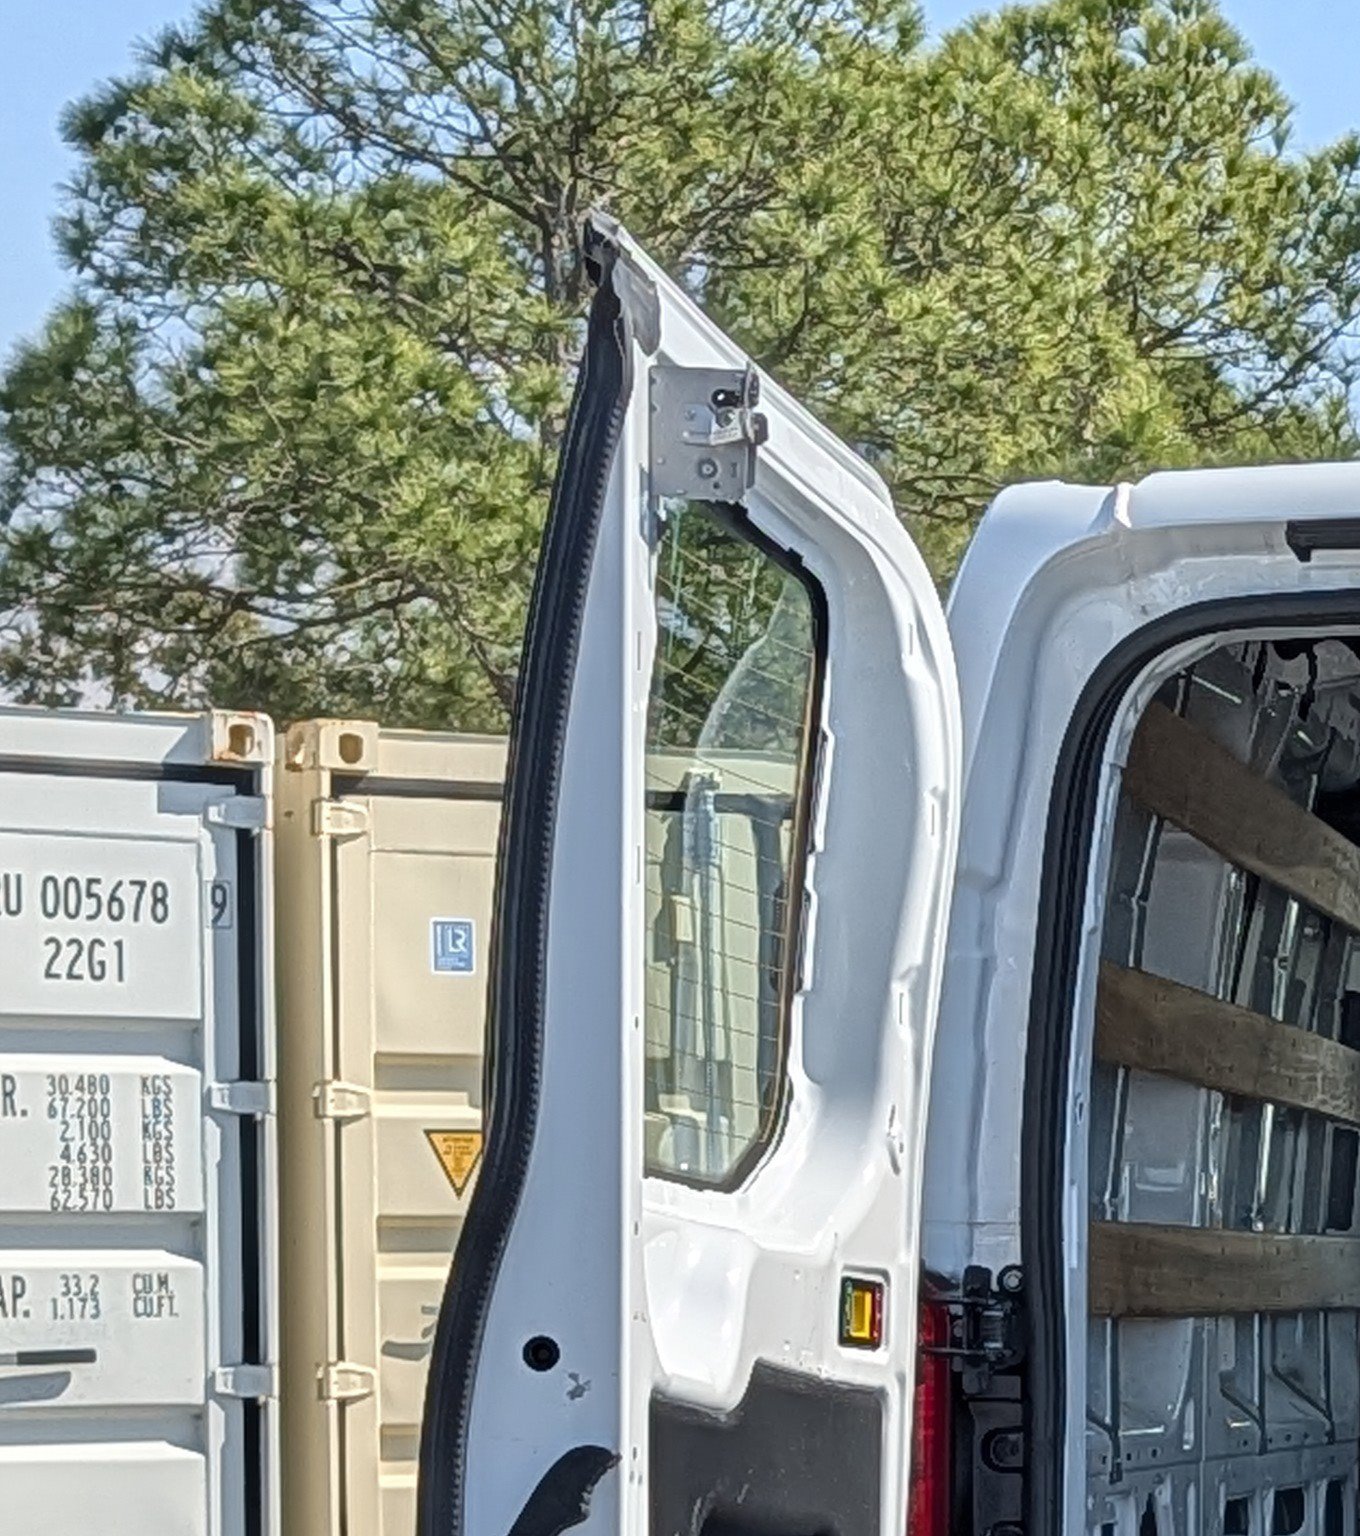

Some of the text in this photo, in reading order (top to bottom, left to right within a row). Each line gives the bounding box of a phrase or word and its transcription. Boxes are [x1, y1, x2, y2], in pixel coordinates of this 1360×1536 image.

[0, 873, 228, 925] U 005678 9
[43, 936, 124, 982] 22G1
[140, 1074, 173, 1096] KGS
[47, 1096, 173, 1119] 67.200 LBS
[59, 1118, 173, 1142] 2.100 KGS
[59, 1141, 175, 1165] 4.630 LBS
[143, 1187, 175, 1210] LBS
[59, 1273, 100, 1297] 33.2
